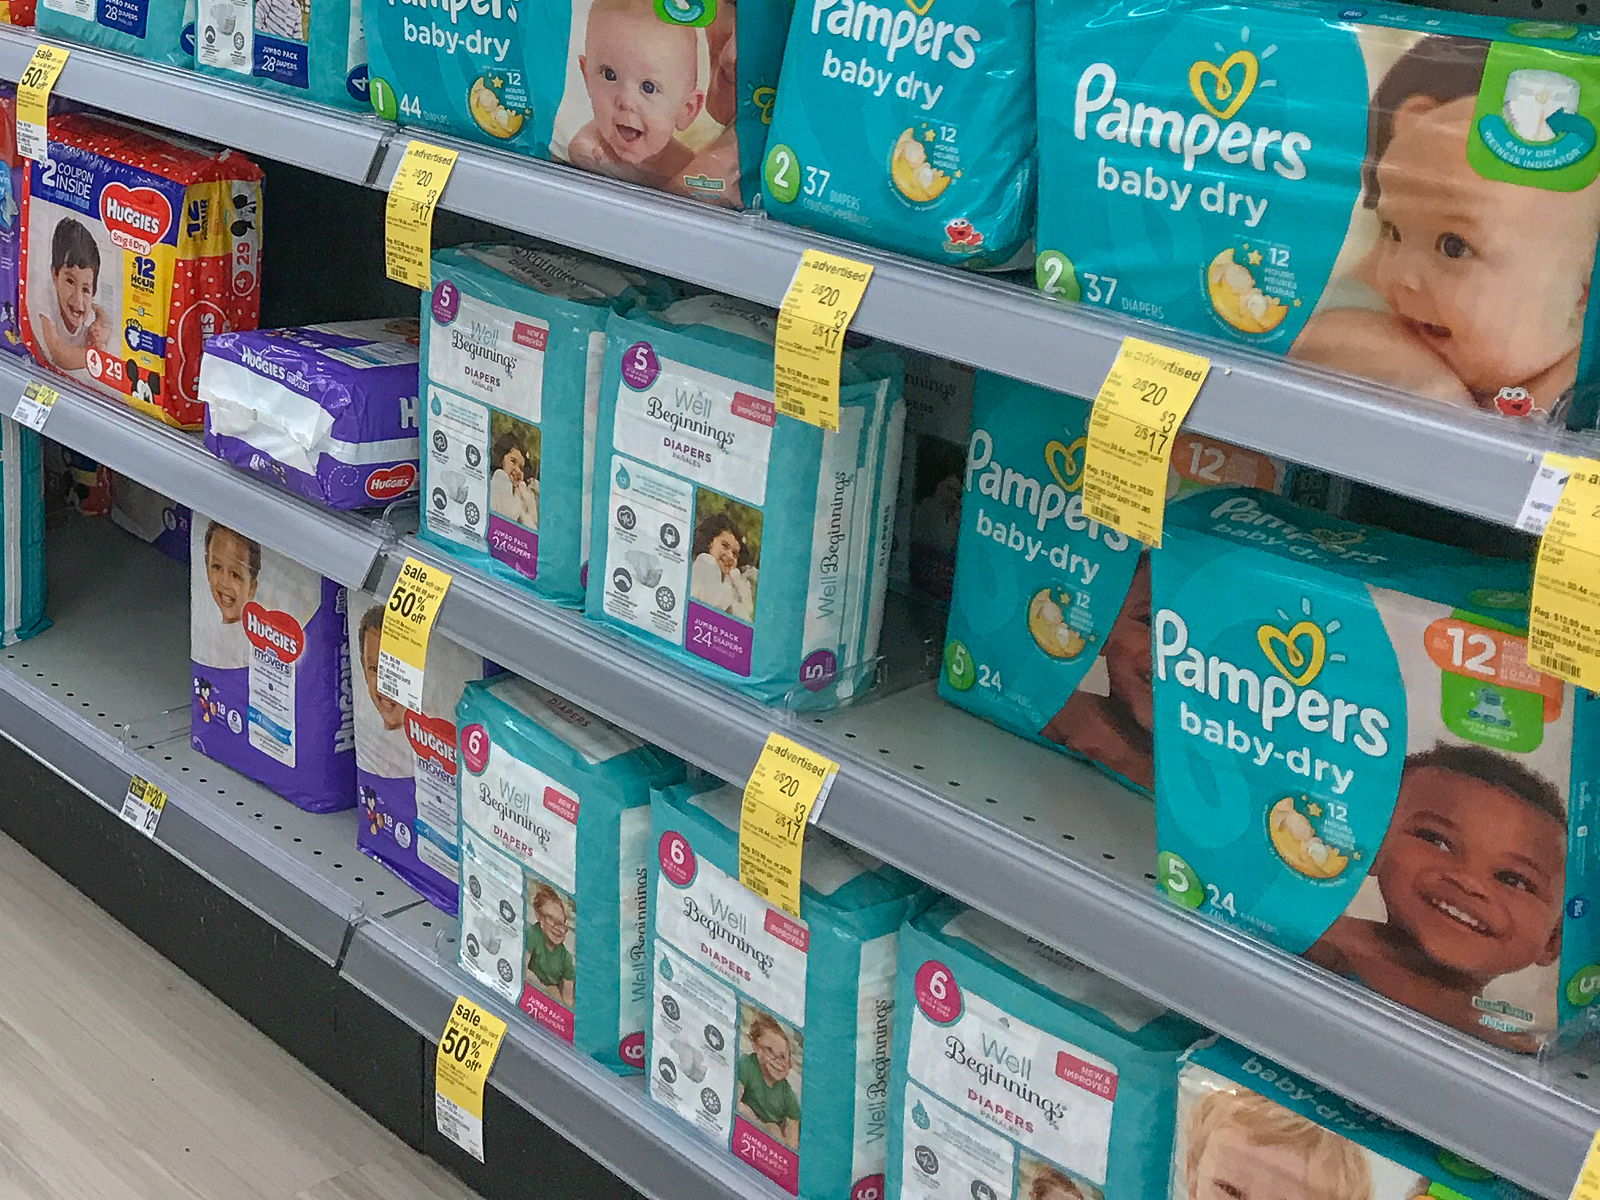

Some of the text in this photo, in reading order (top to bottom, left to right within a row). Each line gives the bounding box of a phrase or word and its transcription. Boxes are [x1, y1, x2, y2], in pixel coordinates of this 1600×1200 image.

[36, 49, 52, 61] sale
[403, 17, 511, 61] baby-dry
[822, 49, 943, 111] baby dry
[400, 94, 422, 121] 44
[1074, 63, 1311, 180] Pampers
[414, 149, 453, 165] advertised
[1483, 129, 1582, 169] WETNESS INDICATOR
[1505, 140, 1557, 158] BABY DRY
[56, 177, 92, 200] INSIDE
[57, 163, 94, 184] COUPON
[803, 165, 831, 198] 37
[1097, 157, 1268, 228] baby dry
[106, 197, 160, 235] HUGGIES
[134, 257, 155, 279] 12
[812, 259, 867, 282] advertised
[1270, 247, 1291, 268] 12
[131, 274, 154, 290] HOUR
[1083, 273, 1117, 305] 37
[1121, 296, 1164, 320] DIAPERS
[470, 321, 499, 344] Well
[105, 359, 123, 380] 29
[241, 348, 286, 382] HUGGIES
[451, 330, 518, 379] Beginnings
[464, 366, 501, 387] DIAPERS
[674, 386, 712, 419] Well
[736, 407, 776, 425] IMPROVED
[646, 397, 736, 455] Beginnings
[1160, 411, 1176, 433] $3
[664, 436, 712, 465] DIAPERS
[370, 475, 409, 492] HUGGIES
[815, 471, 848, 619] Well Beginnings
[976, 509, 1100, 582] baby-dry
[404, 564, 426, 583] sale
[247, 612, 297, 655] HUGGIES
[692, 626, 744, 655] 24 DIAPERS
[694, 617, 739, 644] JUMBO PACK
[254, 647, 290, 675] movers
[1446, 627, 1497, 675] 12
[1155, 608, 1390, 758] Pampers
[775, 746, 825, 778] advertised
[1179, 701, 1354, 794] baby-dry
[499, 777, 531, 813] Well
[479, 784, 551, 852] Beginnings
[794, 802, 806, 823] $3
[493, 824, 534, 857] DIAPERS
[709, 893, 747, 933] Well
[1206, 885, 1237, 916] 24
[684, 896, 775, 977] Beginnings
[700, 942, 751, 983] DIAPERS
[456, 1004, 480, 1027] sale
[866, 999, 894, 1144] Well Beginnings
[980, 1032, 1033, 1081] Well
[944, 1035, 1066, 1121] Beginnings
[1063, 1069, 1112, 1097] IMPROVED
[966, 1089, 1035, 1134] DIAPERS
[1241, 1059, 1366, 1133] baby-dry
[740, 1140, 757, 1160] 21
